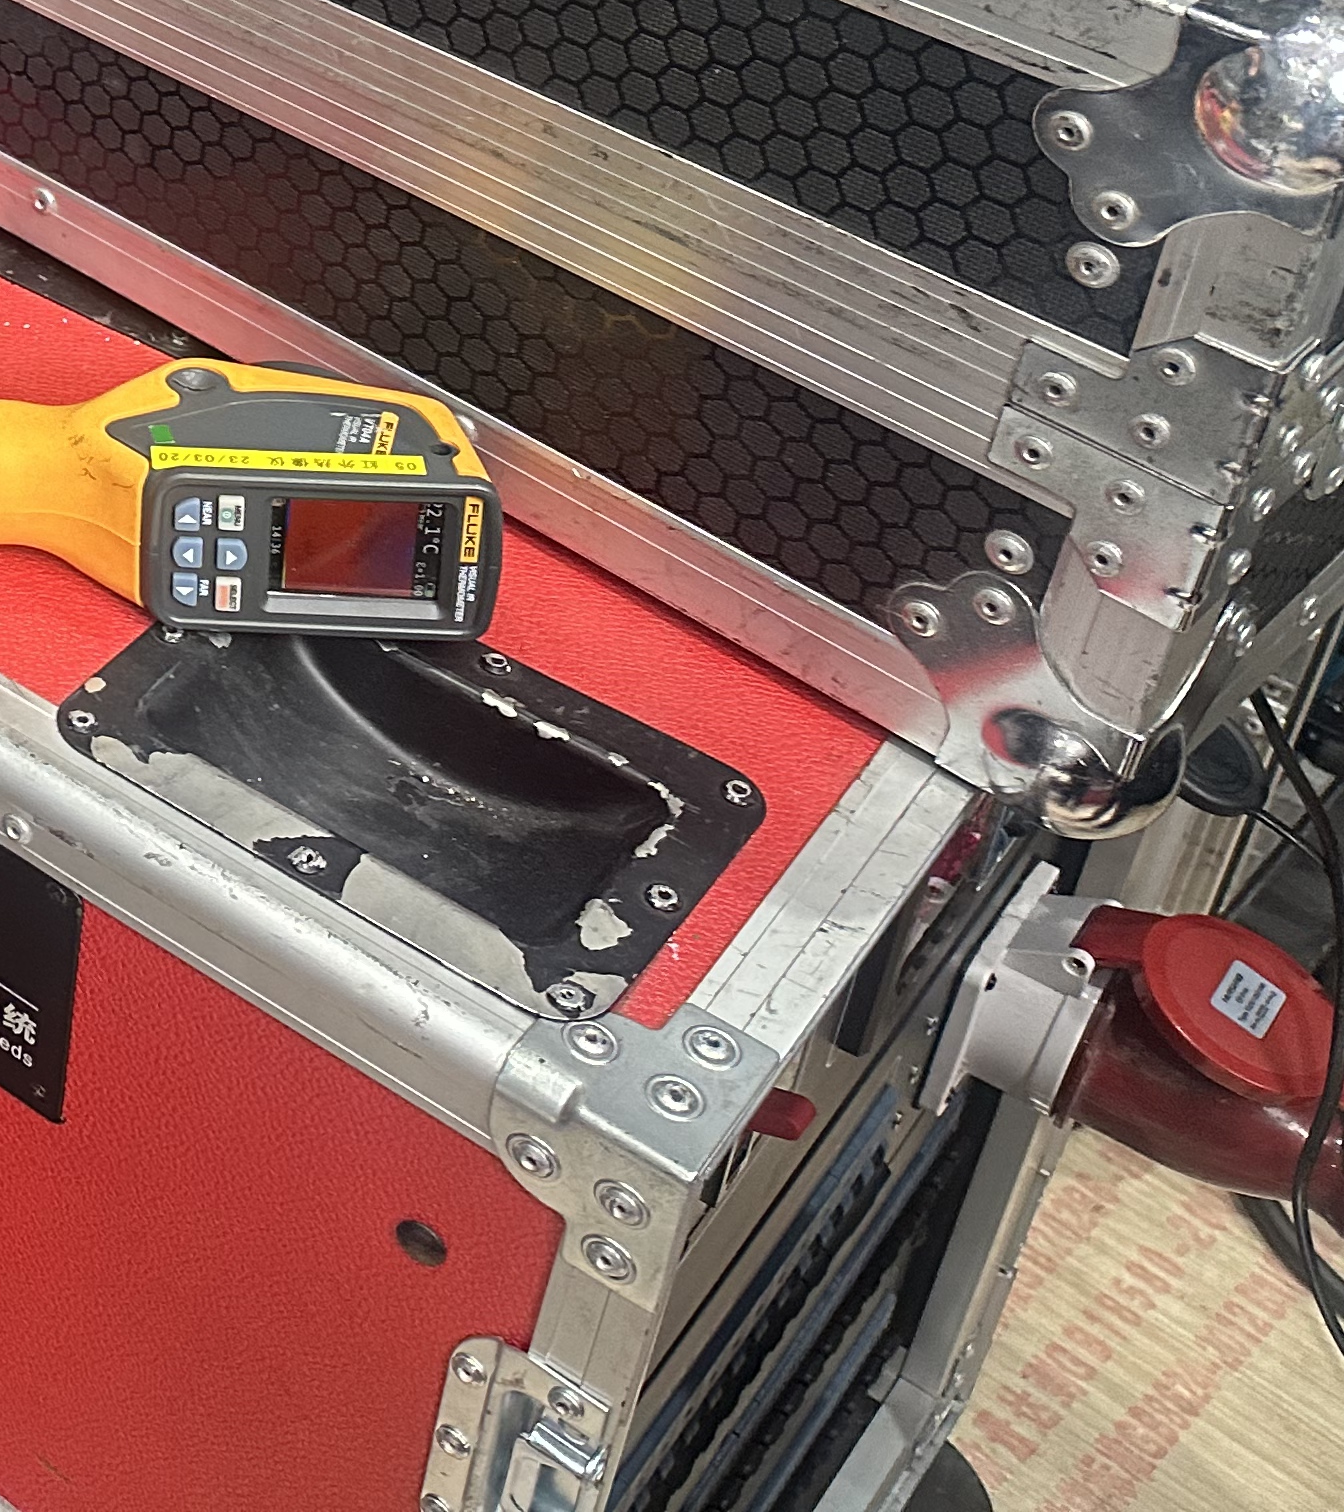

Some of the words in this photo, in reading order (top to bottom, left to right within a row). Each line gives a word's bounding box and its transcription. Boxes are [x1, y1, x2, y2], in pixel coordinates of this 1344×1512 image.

[158, 451, 251, 466] 23/03/20
[201, 500, 213, 526] NEAR
[233, 505, 242, 527] MENU
[463, 503, 480, 558] FLUKE
[198, 579, 210, 597] FAR
[466, 565, 479, 591] VISUAL
[454, 566, 469, 623] THERMOMETER
